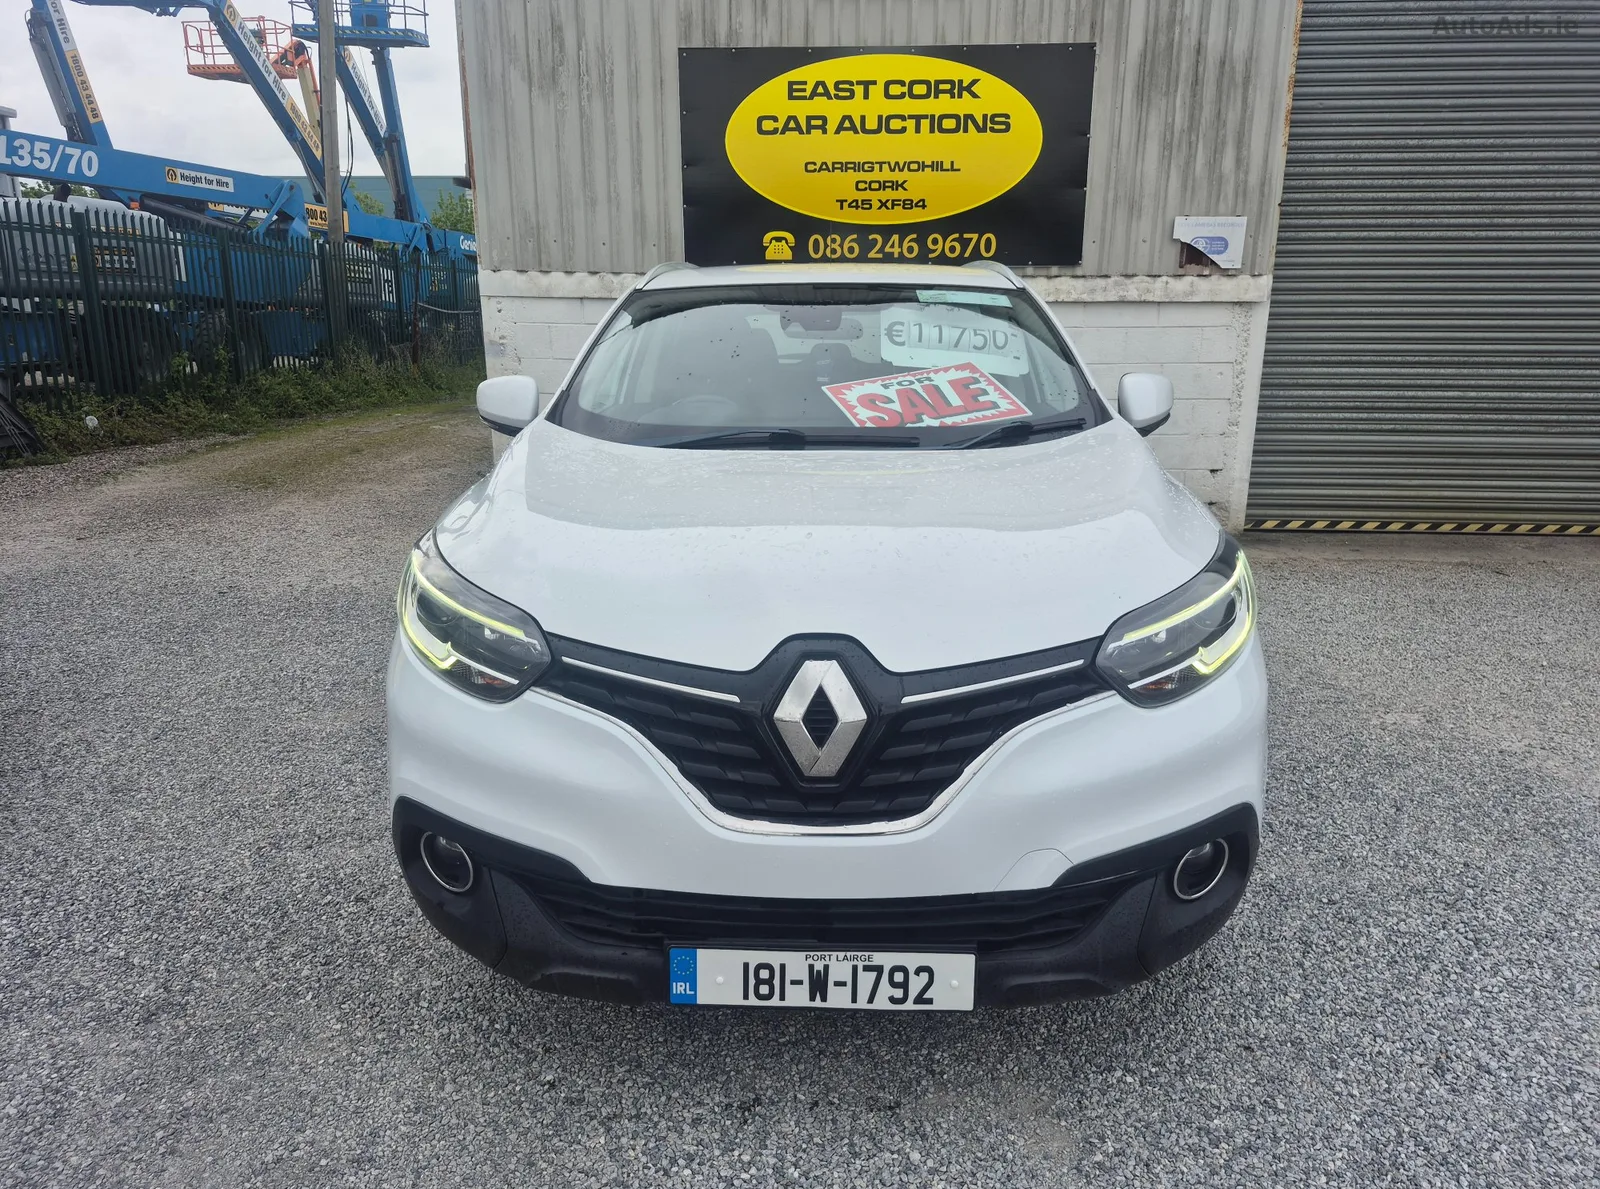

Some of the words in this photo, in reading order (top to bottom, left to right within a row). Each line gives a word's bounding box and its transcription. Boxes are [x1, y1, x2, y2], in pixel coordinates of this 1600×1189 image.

[51, 0, 60, 14] or
[57, 18, 70, 43] Hire
[238, 21, 262, 64] Height
[261, 59, 272, 75] for
[272, 75, 286, 100] Hire
[71, 53, 83, 77] 1800
[80, 80, 89, 91] 43
[86, 93, 94, 105] 44
[90, 107, 99, 119] 48
[787, 80, 881, 101] EAST
[883, 78, 981, 100] CORK
[756, 114, 828, 136] CAR
[834, 113, 1011, 135] AUCTIONS
[804, 160, 961, 174] CARRIGTWOHILL
[180, 172, 203, 185] Height
[204, 176, 214, 187] for
[216, 178, 230, 188] Hire
[854, 180, 909, 192] CORK
[835, 198, 873, 211] T45
[876, 198, 927, 211] XF84
[305, 208, 318, 220] 800
[319, 210, 327, 222] 43
[808, 234, 860, 259] 086
[867, 233, 919, 259] 246
[927, 232, 997, 258] 9670
[880, 376, 934, 390] FOR
[856, 375, 995, 428] SALE
[805, 954, 833, 962] PORT
[836, 952, 874, 963] LÁIRGE
[673, 982, 695, 995] IRL
[742, 961, 935, 1005] 181-W-1792
